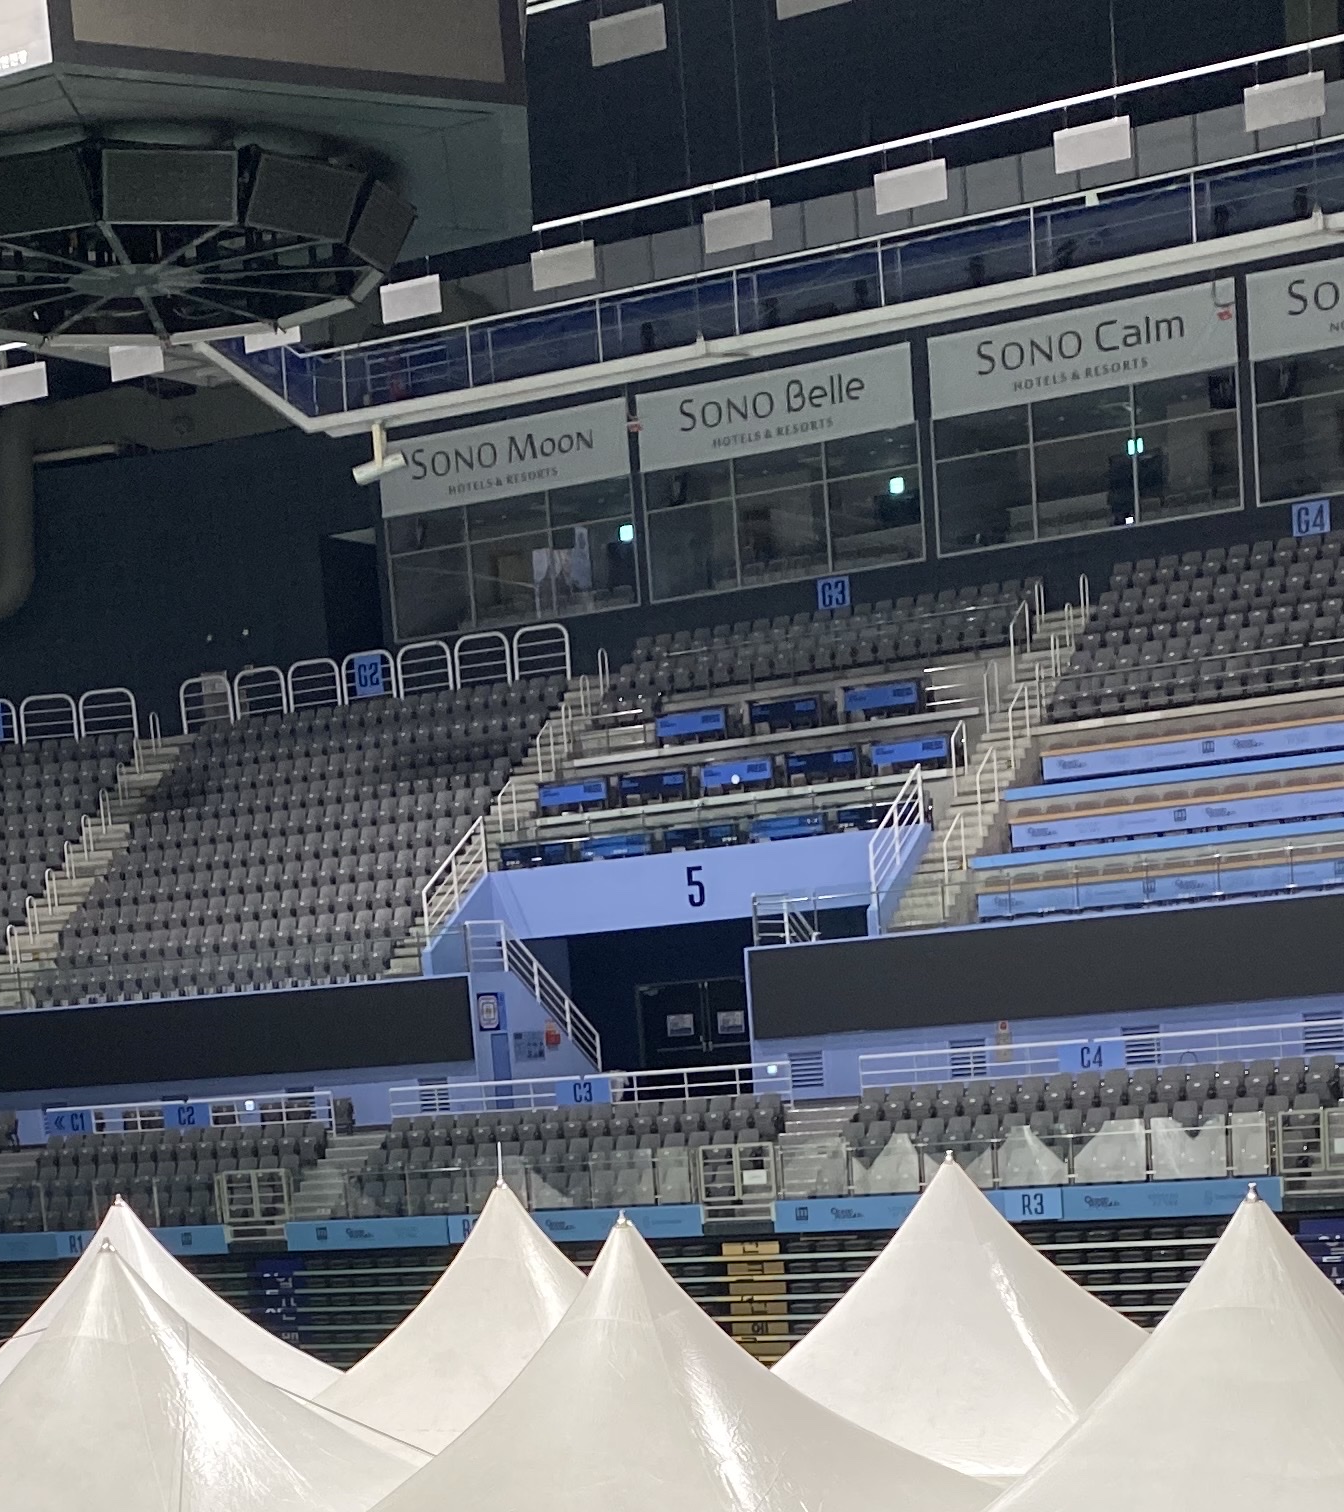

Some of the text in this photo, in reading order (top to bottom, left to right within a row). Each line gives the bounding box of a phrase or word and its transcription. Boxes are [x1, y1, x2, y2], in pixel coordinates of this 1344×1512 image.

[977, 315, 1185, 375] SONO Calm
[1013, 356, 1149, 392] HOTELS & RESORTS
[680, 374, 866, 431] SONO Belle
[712, 430, 762, 449] HOTELS
[776, 417, 834, 437] RESORTS
[411, 441, 498, 480] SONO
[447, 477, 493, 496] HOTELS
[1297, 504, 1326, 535] G4
[821, 580, 847, 608] G3
[686, 865, 705, 907] 5
[1080, 1046, 1103, 1069] C4
[573, 1081, 593, 1103] C3
[177, 1106, 195, 1126] C2
[1022, 1192, 1044, 1216] R3
